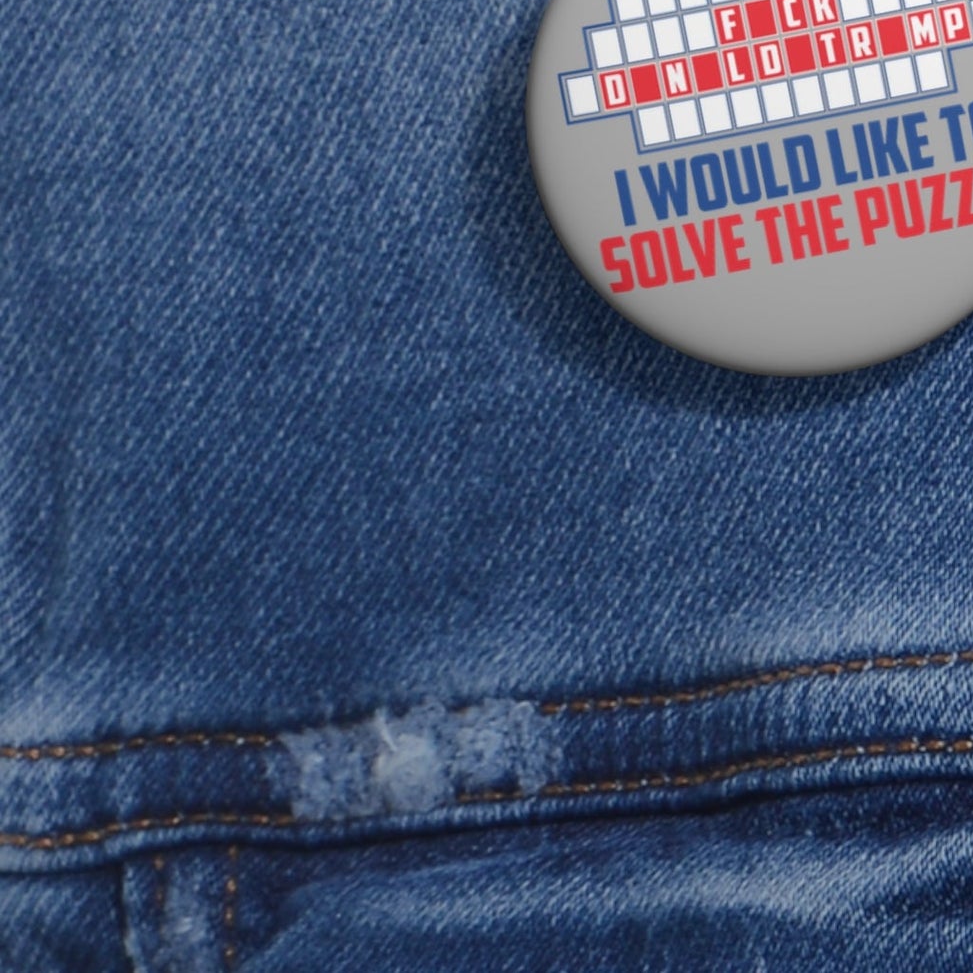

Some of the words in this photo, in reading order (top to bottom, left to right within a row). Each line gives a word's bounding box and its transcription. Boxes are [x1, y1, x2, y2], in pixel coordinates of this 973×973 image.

[614, 170, 637, 227] I
[639, 134, 821, 221] WOULD
[826, 112, 934, 186] LIKE
[600, 214, 752, 293] SOLVE
[755, 194, 850, 265] THE
